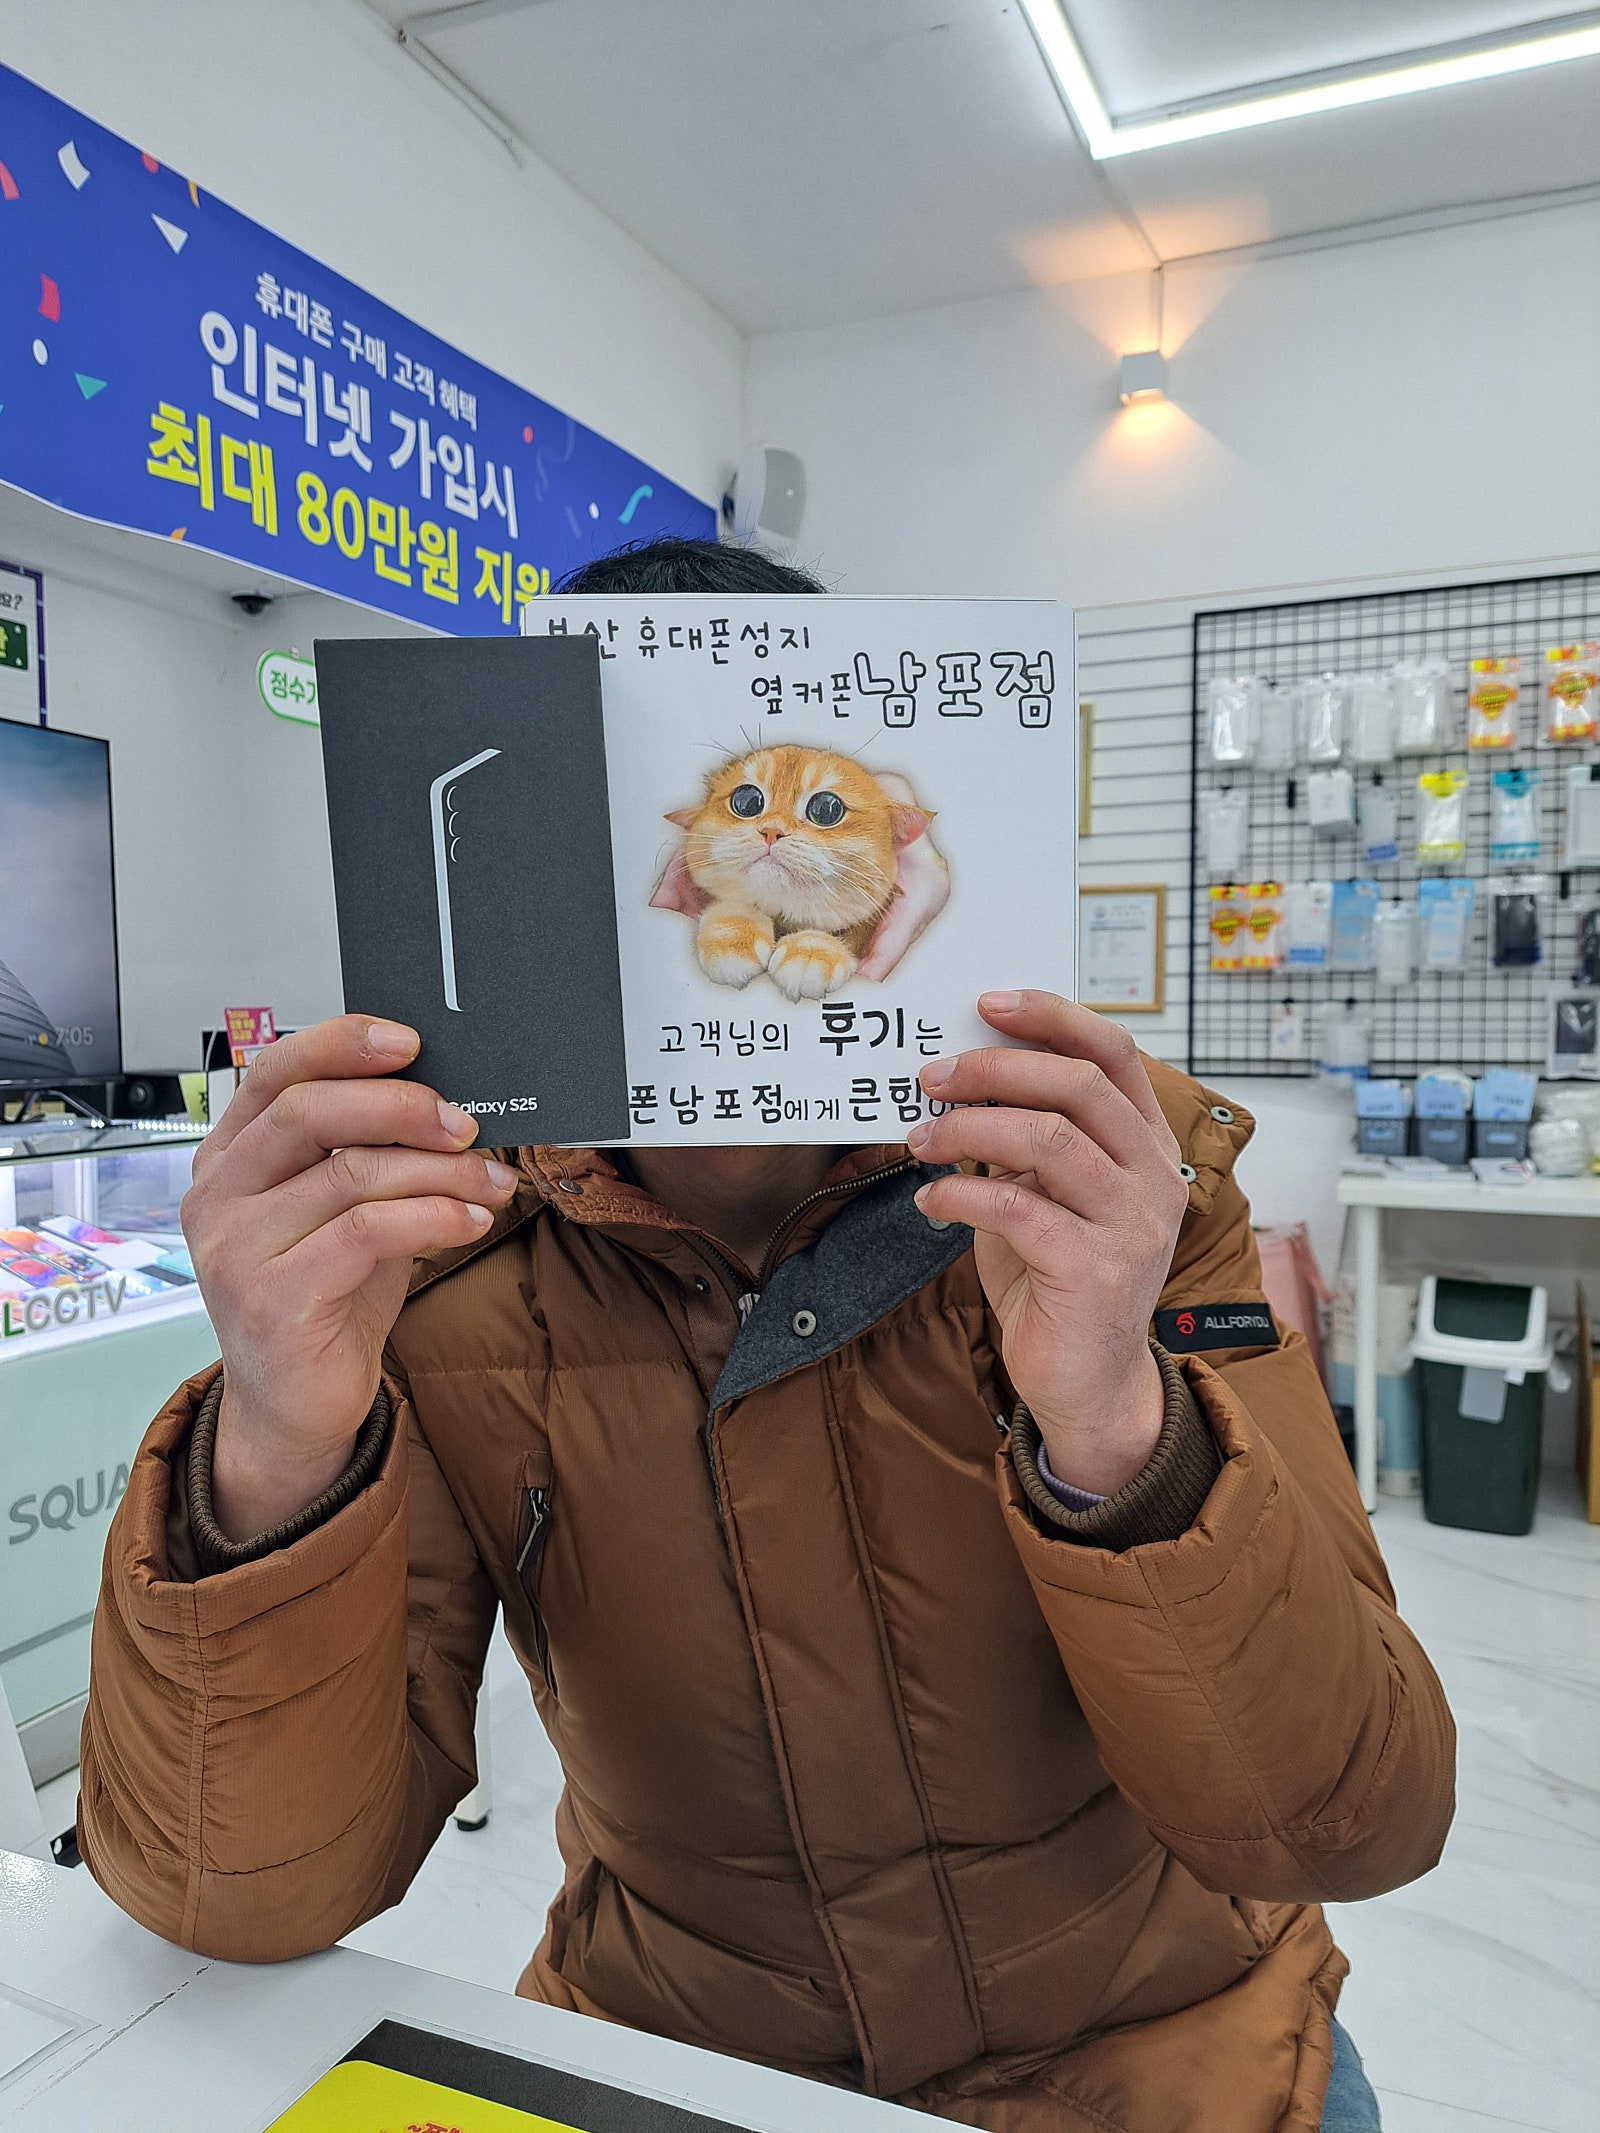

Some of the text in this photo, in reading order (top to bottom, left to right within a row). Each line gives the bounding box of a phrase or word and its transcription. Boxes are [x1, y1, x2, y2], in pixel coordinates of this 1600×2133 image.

[255, 272, 478, 431] 휴대폰 구매 고객 혜택
[200, 310, 519, 539] 인터넷 가입시
[146, 400, 279, 537] 최대
[296, 471, 460, 605] 80만원
[55, 1025, 94, 1047] 7:05
[659, 1001, 944, 1057] 고객님의 후기는
[509, 1097, 538, 1112] S25
